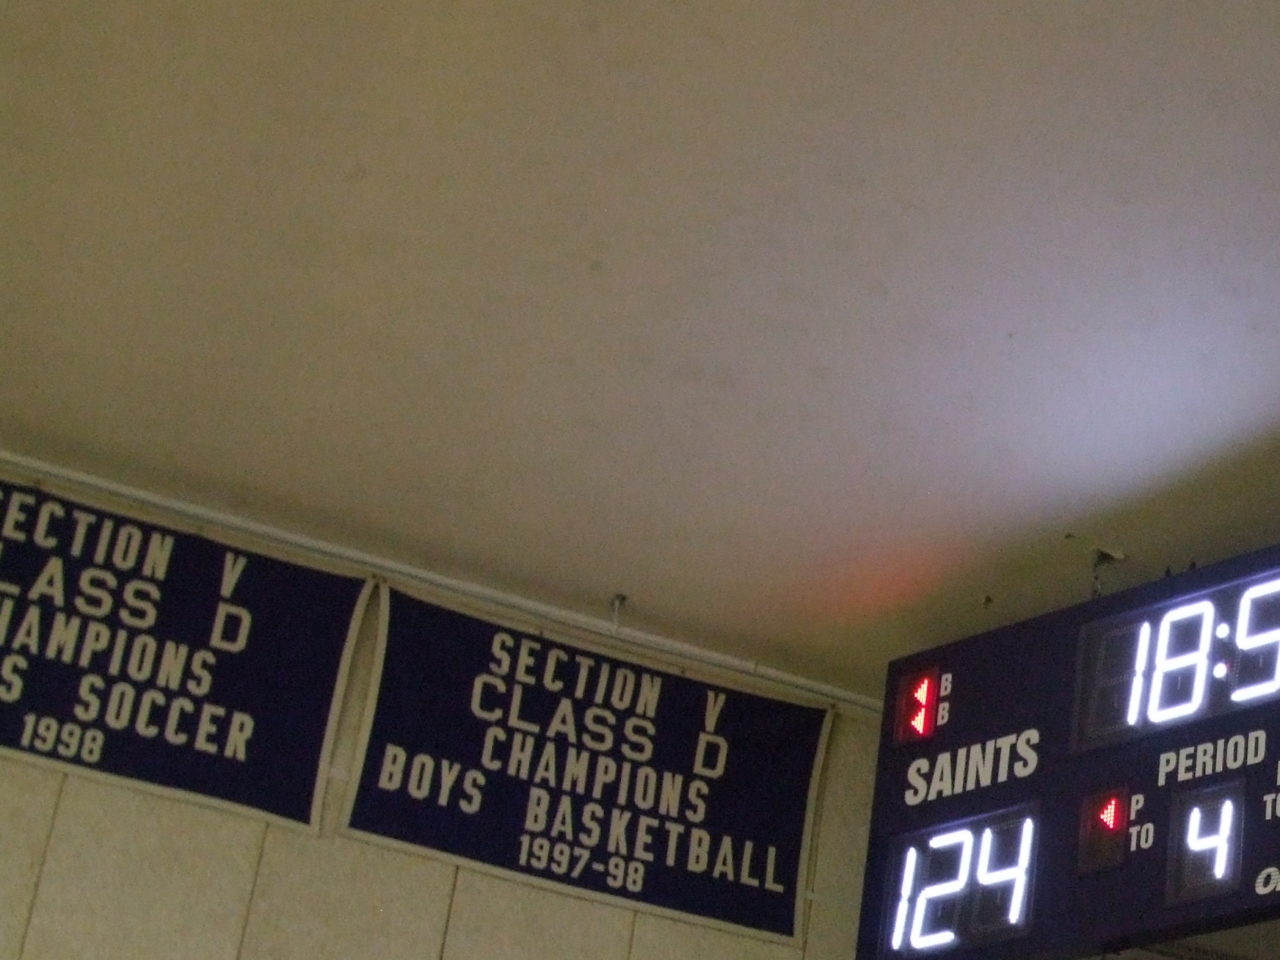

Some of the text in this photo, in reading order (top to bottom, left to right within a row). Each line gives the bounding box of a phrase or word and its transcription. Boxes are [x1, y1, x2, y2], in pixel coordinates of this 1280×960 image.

[0, 488, 247, 598] ECTION V
[209, 601, 252, 653] D
[73, 674, 255, 761] SOCCER
[489, 632, 726, 734] SECTION V
[937, 703, 950, 726] B
[940, 673, 952, 697] B
[20, 712, 105, 764] 1998
[470, 673, 728, 779] CLASS D
[1158, 730, 1267, 786] PERIOD
[480, 727, 709, 824] CHAMPIONS
[904, 728, 1040, 806] SAINTS
[377, 743, 784, 893] BOYS BASKETBALL
[1129, 822, 1154, 852] TO
[1130, 794, 1144, 820] P
[1186, 799, 1234, 879] 4
[519, 833, 645, 893] 1997-98
[892, 818, 1034, 950] 124
